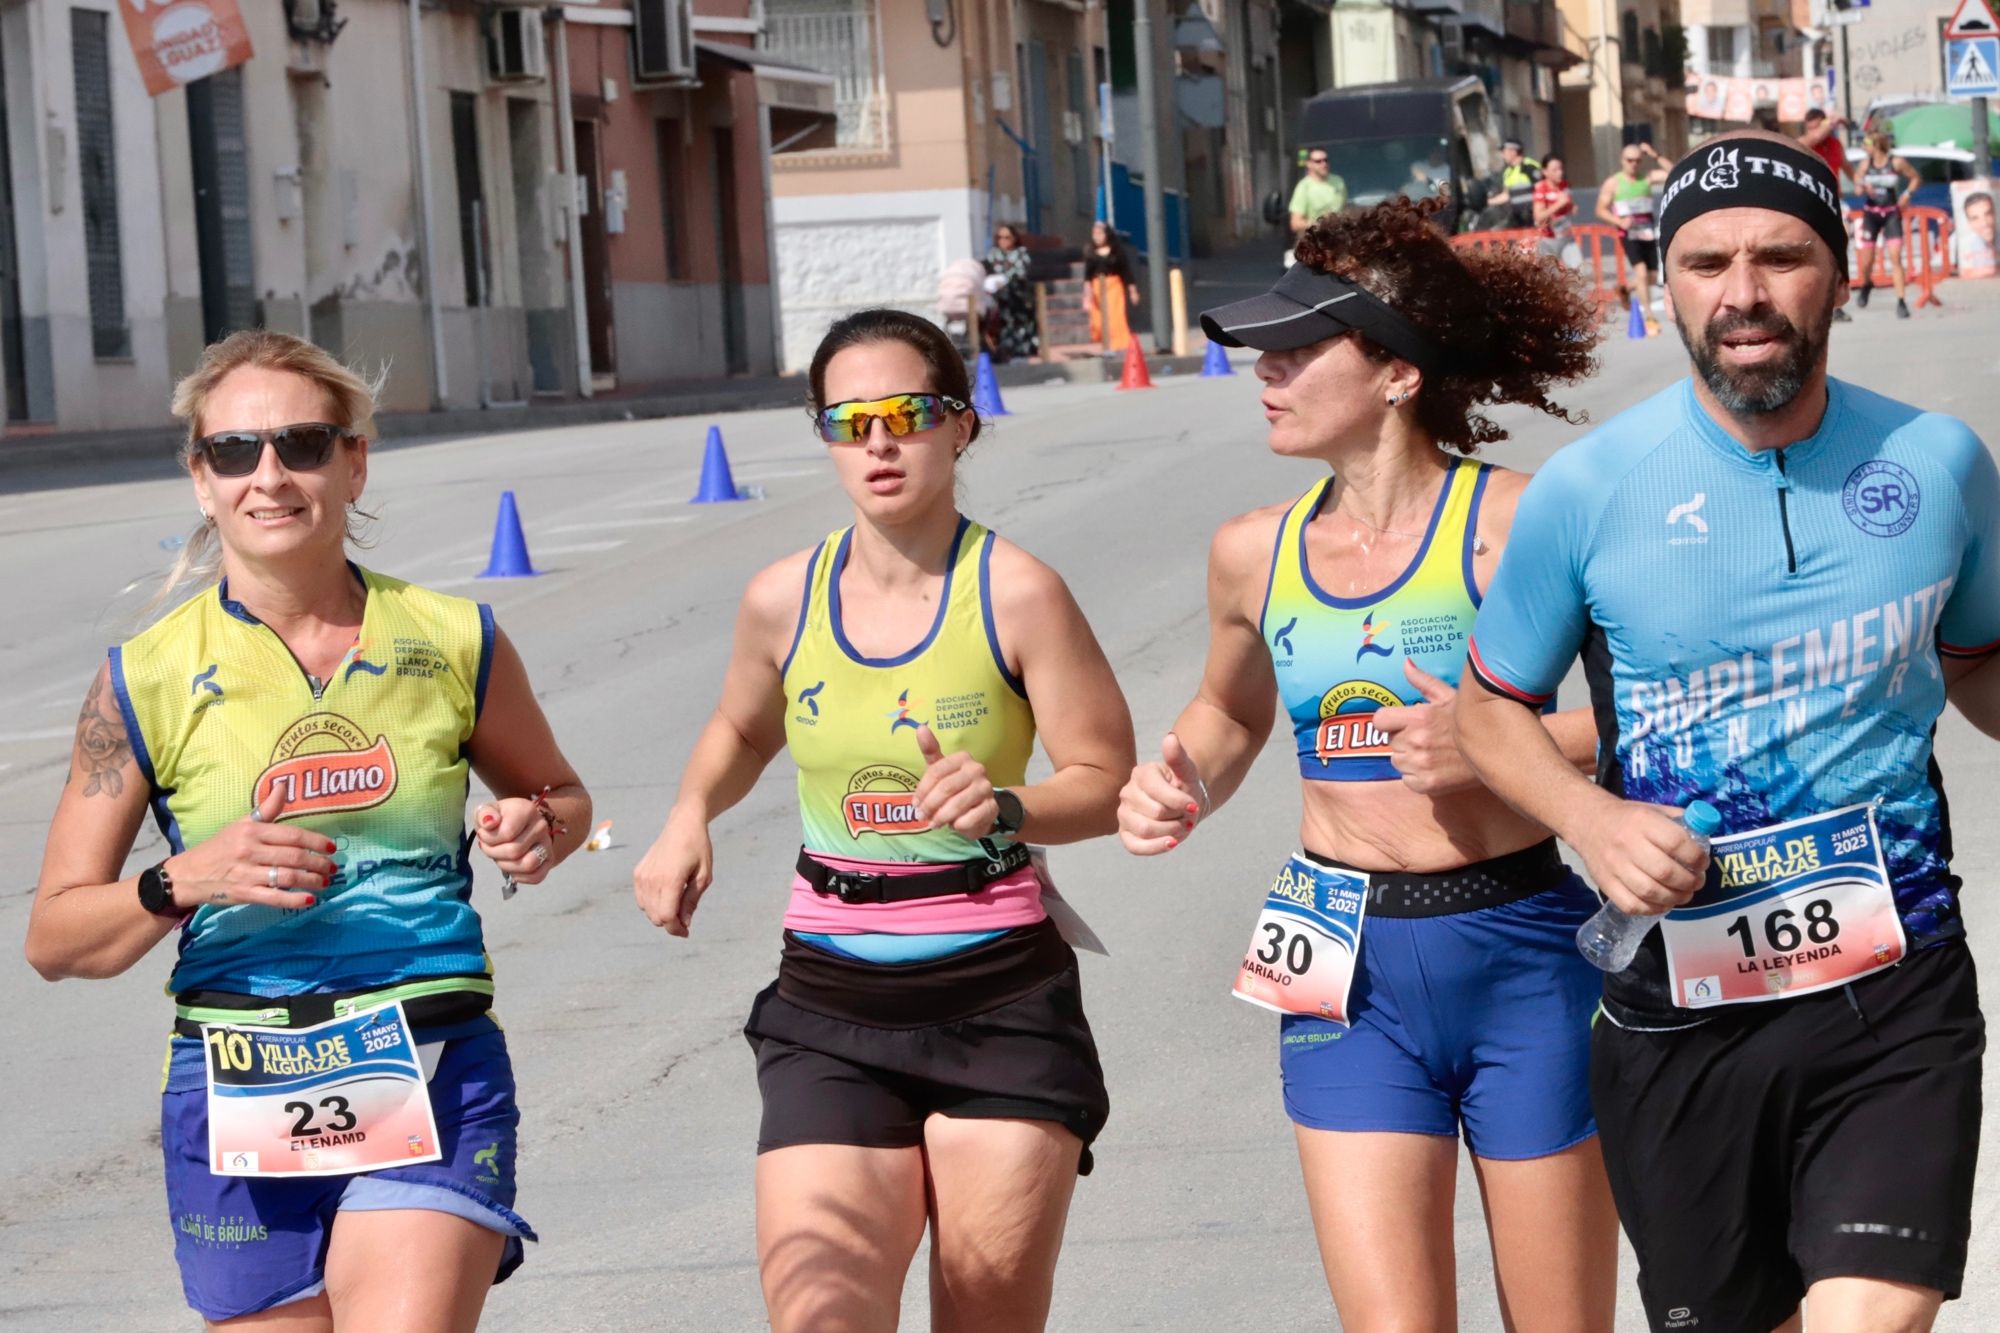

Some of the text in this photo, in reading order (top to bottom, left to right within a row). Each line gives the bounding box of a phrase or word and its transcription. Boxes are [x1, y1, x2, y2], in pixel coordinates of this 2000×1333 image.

[1744, 156, 1837, 216] TRAIL
[1861, 484, 1905, 514] SR
[1401, 615, 1457, 626] ASOCIACIÓN
[1401, 624, 1454, 635] DEPORTIVA
[1402, 632, 1464, 646] LLANO DE
[1403, 643, 1452, 655] BRUJAS
[396, 656, 449, 673] LLANO DE
[396, 667, 433, 678] BRUJAS
[935, 691, 985, 704] ASOCIACIÓN
[936, 700, 982, 712] DEPORTIVA
[1324, 686, 1395, 713] frutos secos
[936, 706, 989, 721] LLANO DE
[937, 717, 979, 730] BRUJAS
[280, 719, 358, 754] frutos secos
[1325, 724, 1346, 750] El
[304, 764, 385, 798] Llano
[855, 769, 914, 788] frutos secos
[851, 802, 920, 823] El Llan
[1831, 825, 1866, 842] 21 MAYO
[1714, 834, 1816, 874] VILLA DE
[1833, 834, 1869, 856] 2023
[1720, 855, 1821, 888] ALGUAZAS
[1299, 872, 1316, 896] DE
[1328, 887, 1338, 896] 21
[1340, 889, 1361, 901] MAYO
[1326, 897, 1358, 914] 2023
[1727, 898, 1840, 959] 168
[1256, 922, 1313, 976] 30
[1737, 943, 1843, 974] LA LEYENDA
[361, 1022, 398, 1041] 21 MAYO
[1307, 1032, 1343, 1043] BRUJAS
[257, 1035, 349, 1062] VILLA DE
[364, 1031, 402, 1053] 2023
[263, 1050, 352, 1076] ALGUAZAS
[284, 1095, 357, 1138] 23
[290, 1132, 366, 1151] ELENAMD
[204, 1224, 215, 1241] DE
[218, 1225, 269, 1242] BRUJAS
